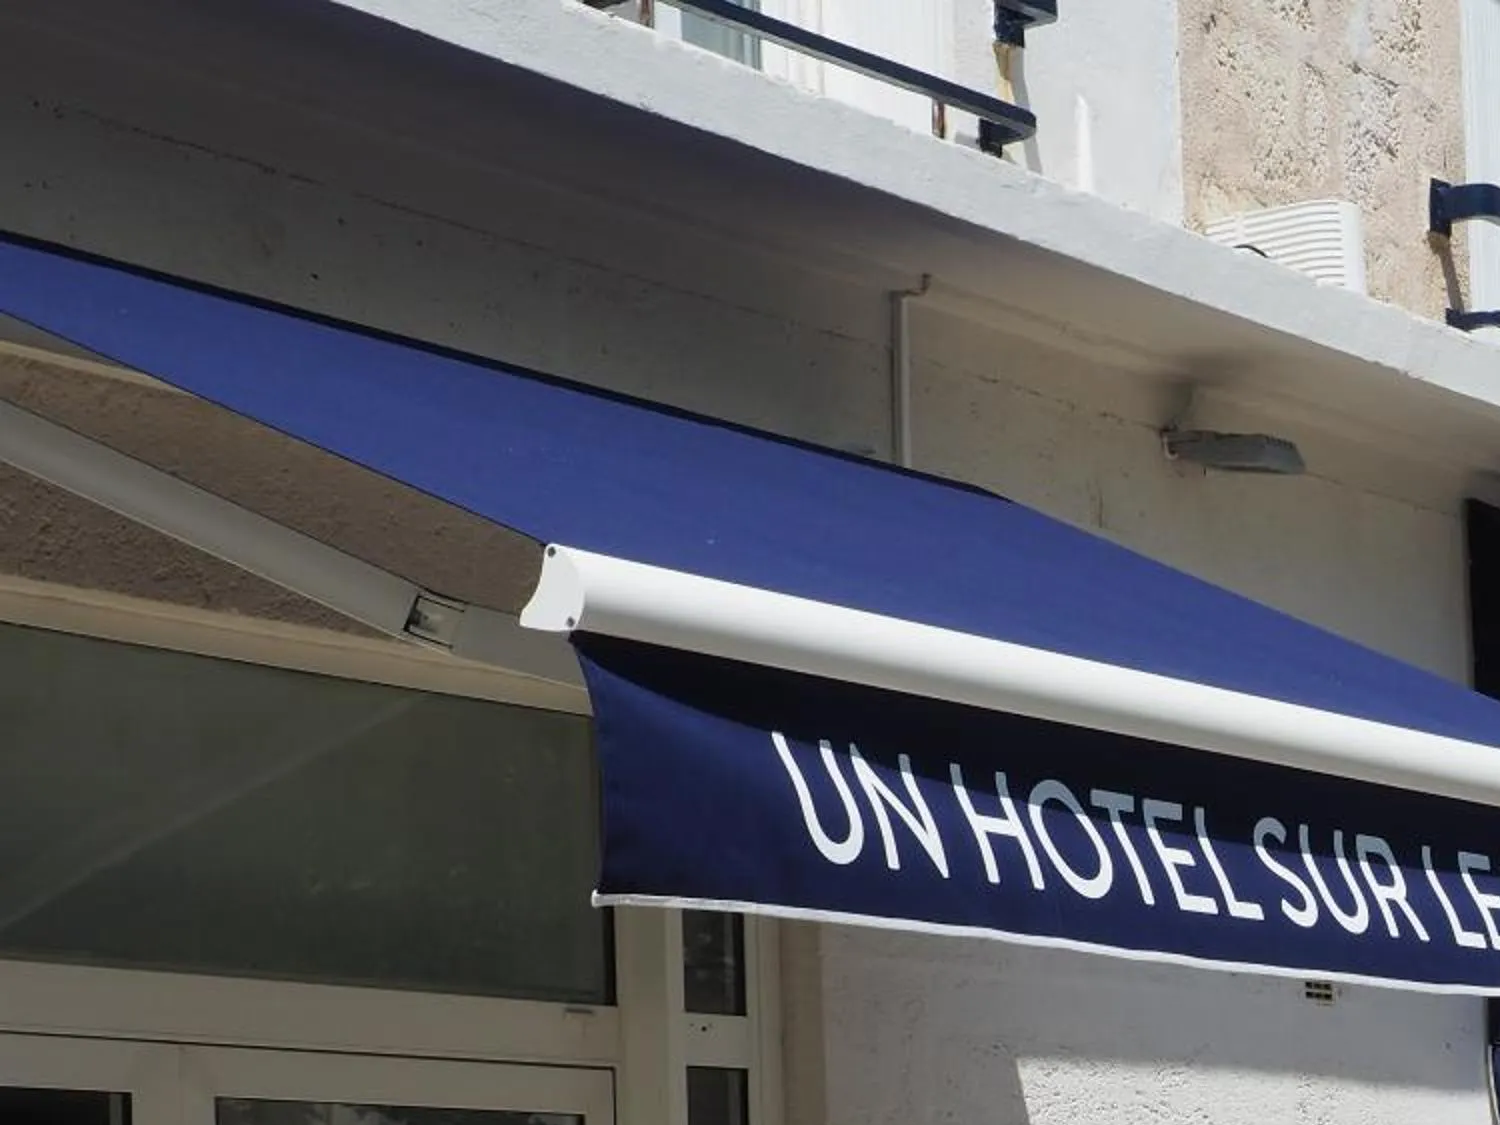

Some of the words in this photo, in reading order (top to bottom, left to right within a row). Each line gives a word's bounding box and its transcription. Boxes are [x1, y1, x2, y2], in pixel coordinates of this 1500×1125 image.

[770, 730, 950, 879] UN
[949, 761, 1265, 921] HOTEL
[1252, 816, 1430, 942] SUR
